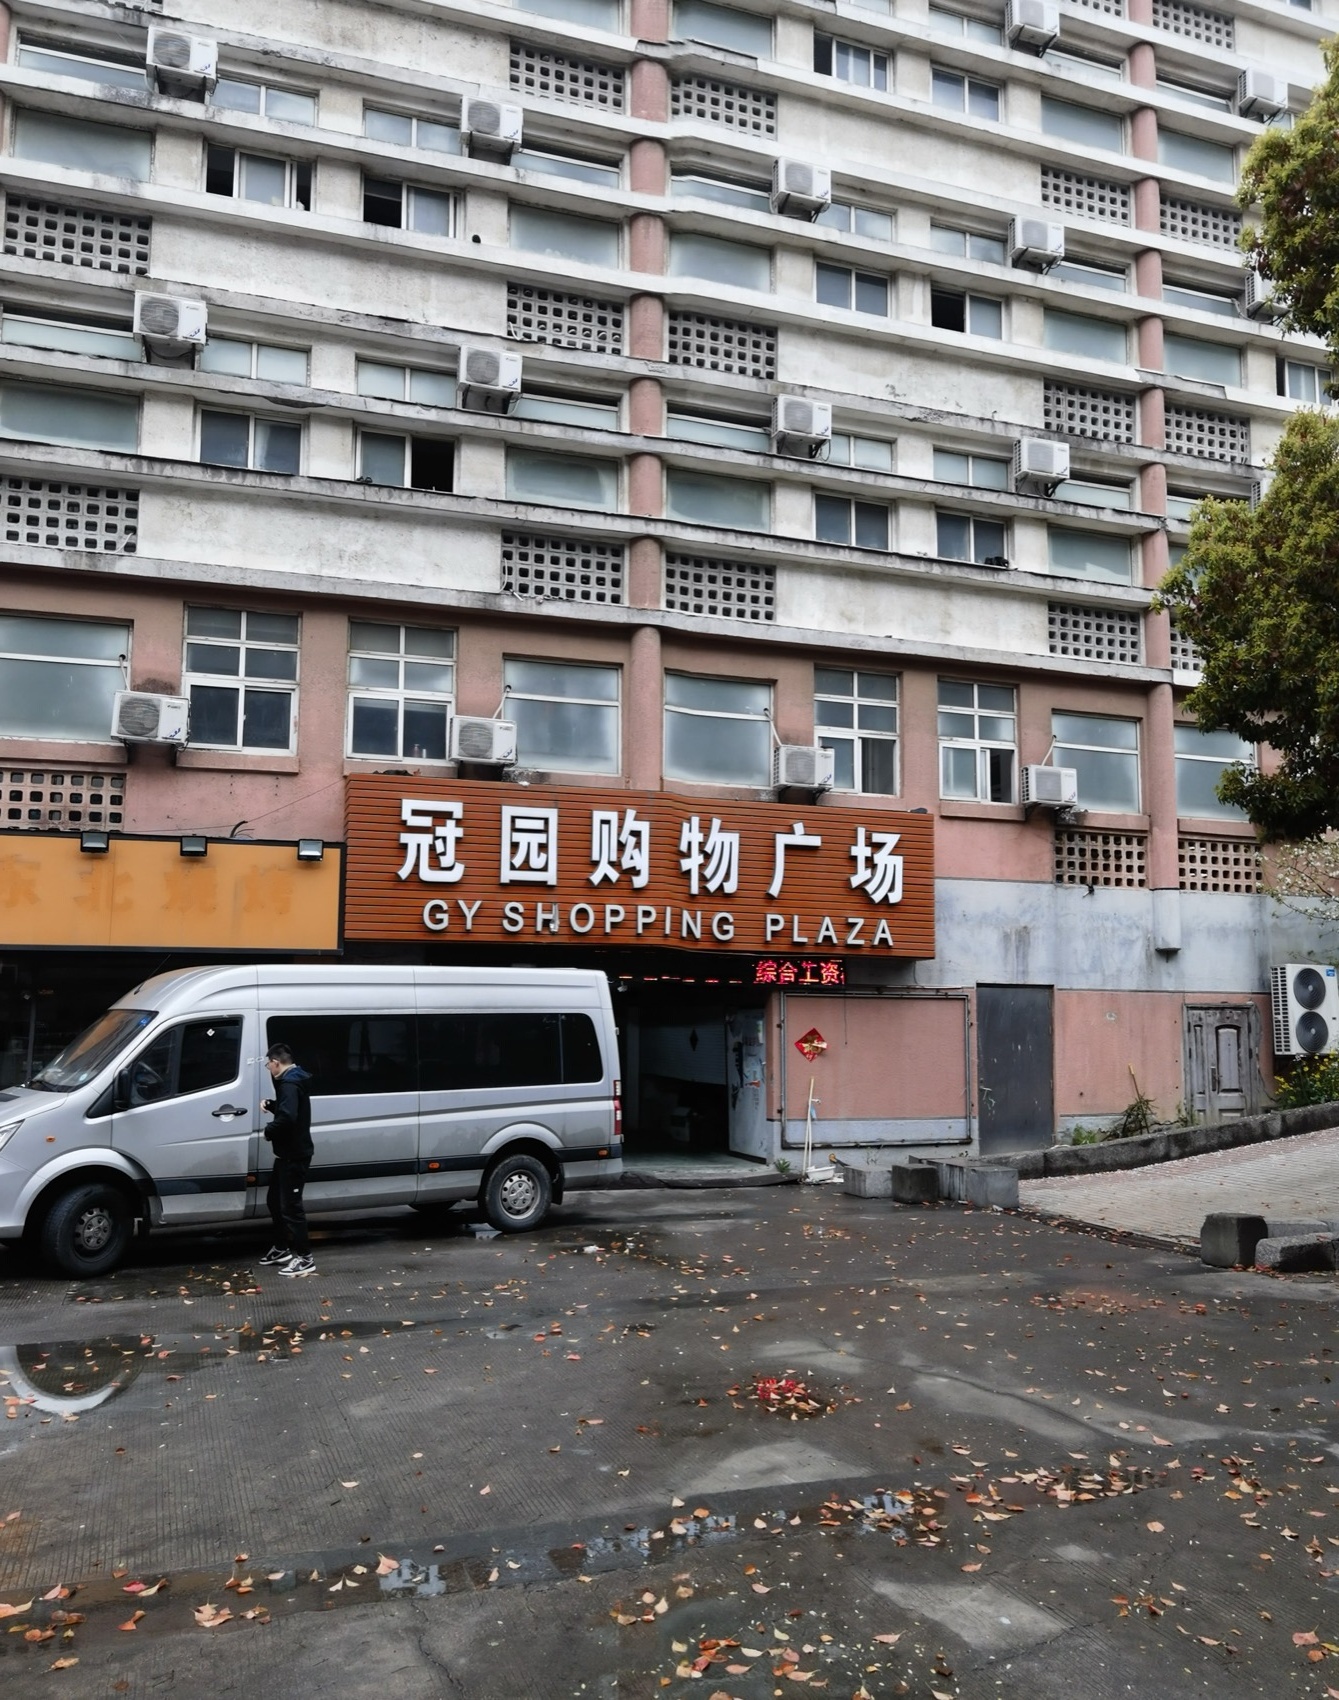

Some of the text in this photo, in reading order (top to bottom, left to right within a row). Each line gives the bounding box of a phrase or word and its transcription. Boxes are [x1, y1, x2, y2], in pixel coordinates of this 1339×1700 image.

[397, 797, 905, 905] 冠园购物广场
[422, 899, 895, 948] GY SHOPPING PLAZA
[755, 960, 845, 985] 综合工资
